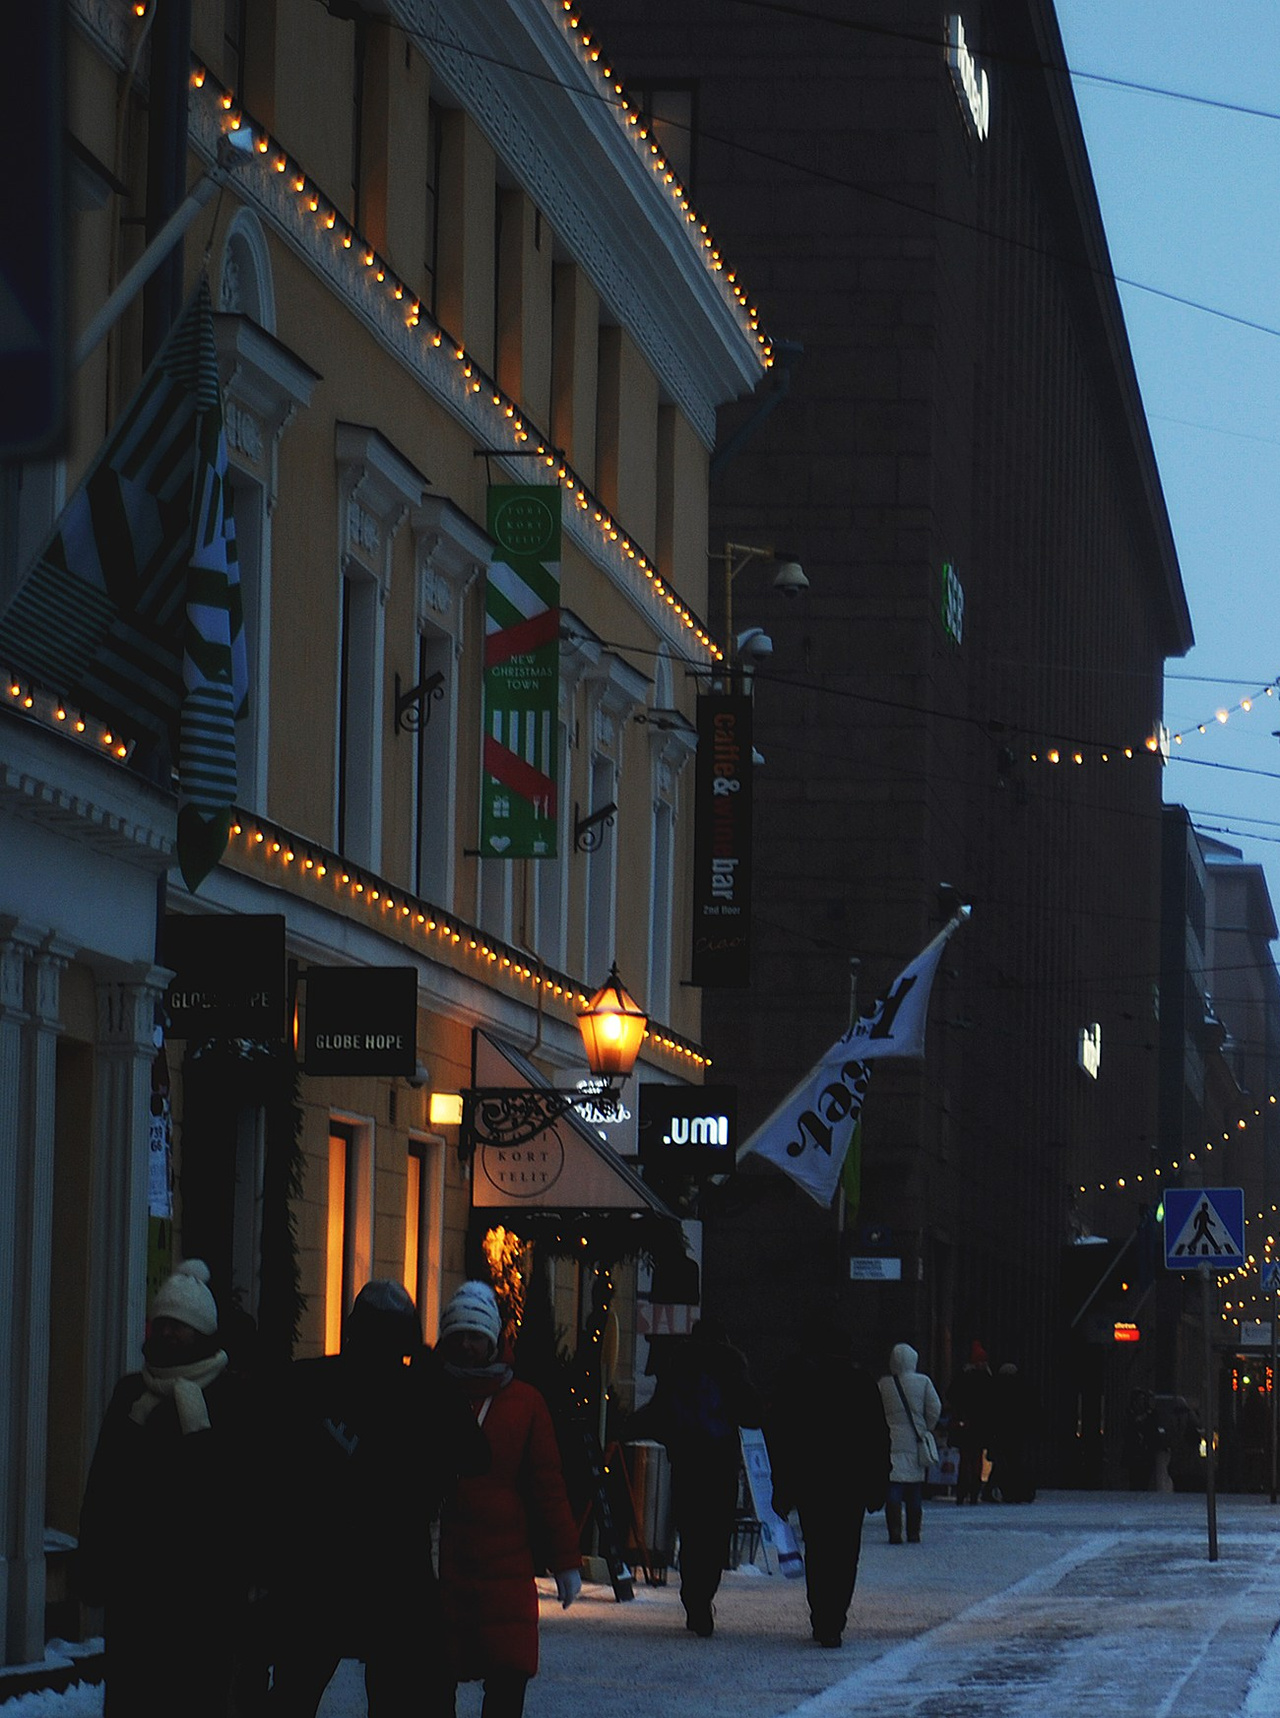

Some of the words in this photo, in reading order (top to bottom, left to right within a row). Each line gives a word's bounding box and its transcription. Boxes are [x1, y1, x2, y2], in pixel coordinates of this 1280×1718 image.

[510, 654, 537, 664] NEW
[492, 666, 553, 677] CHRISTMAS
[507, 680, 540, 690] TOWN
[316, 1034, 361, 1049] GLOBE
[365, 1034, 403, 1049] HOPE
[498, 1151, 548, 1161] KORT
